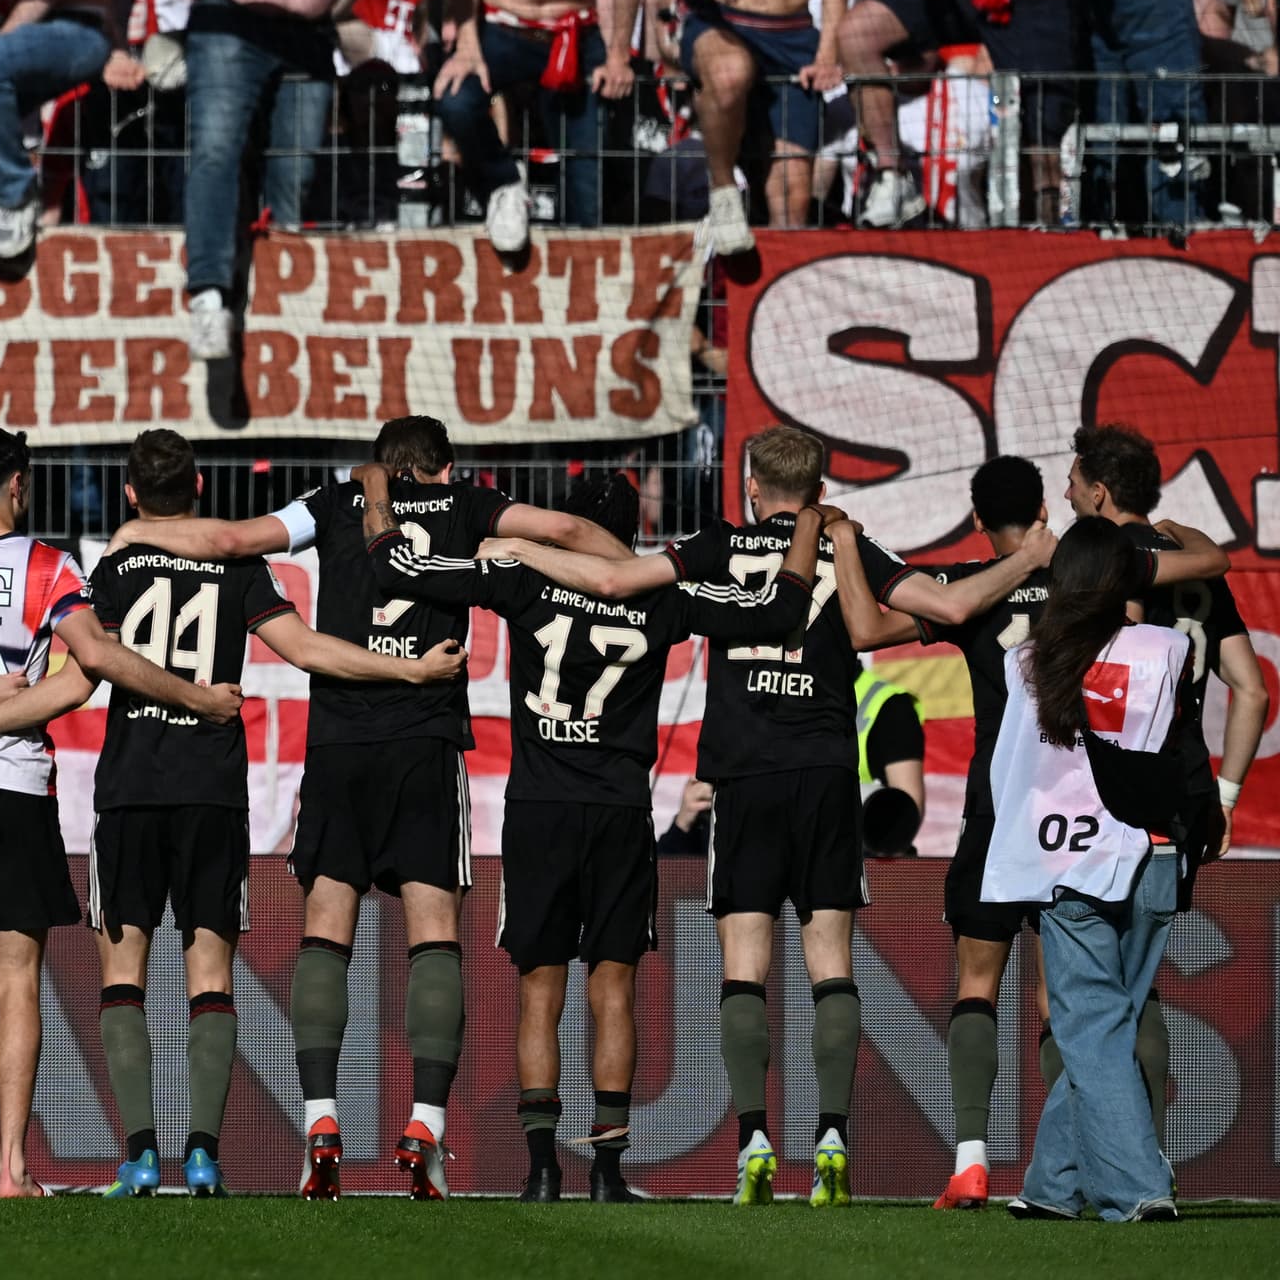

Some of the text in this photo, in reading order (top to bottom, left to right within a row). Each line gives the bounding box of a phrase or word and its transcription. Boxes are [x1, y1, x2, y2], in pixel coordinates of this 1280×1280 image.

[240, 329, 420, 422] BEI
[450, 332, 664, 424] UNS
[746, 252, 1280, 556] SC
[730, 533, 743, 549] FC
[121, 577, 220, 690] 44
[368, 634, 418, 660] KANE
[523, 612, 649, 721] 17
[538, 718, 600, 744] OLISE
[1037, 813, 1100, 853] 02
